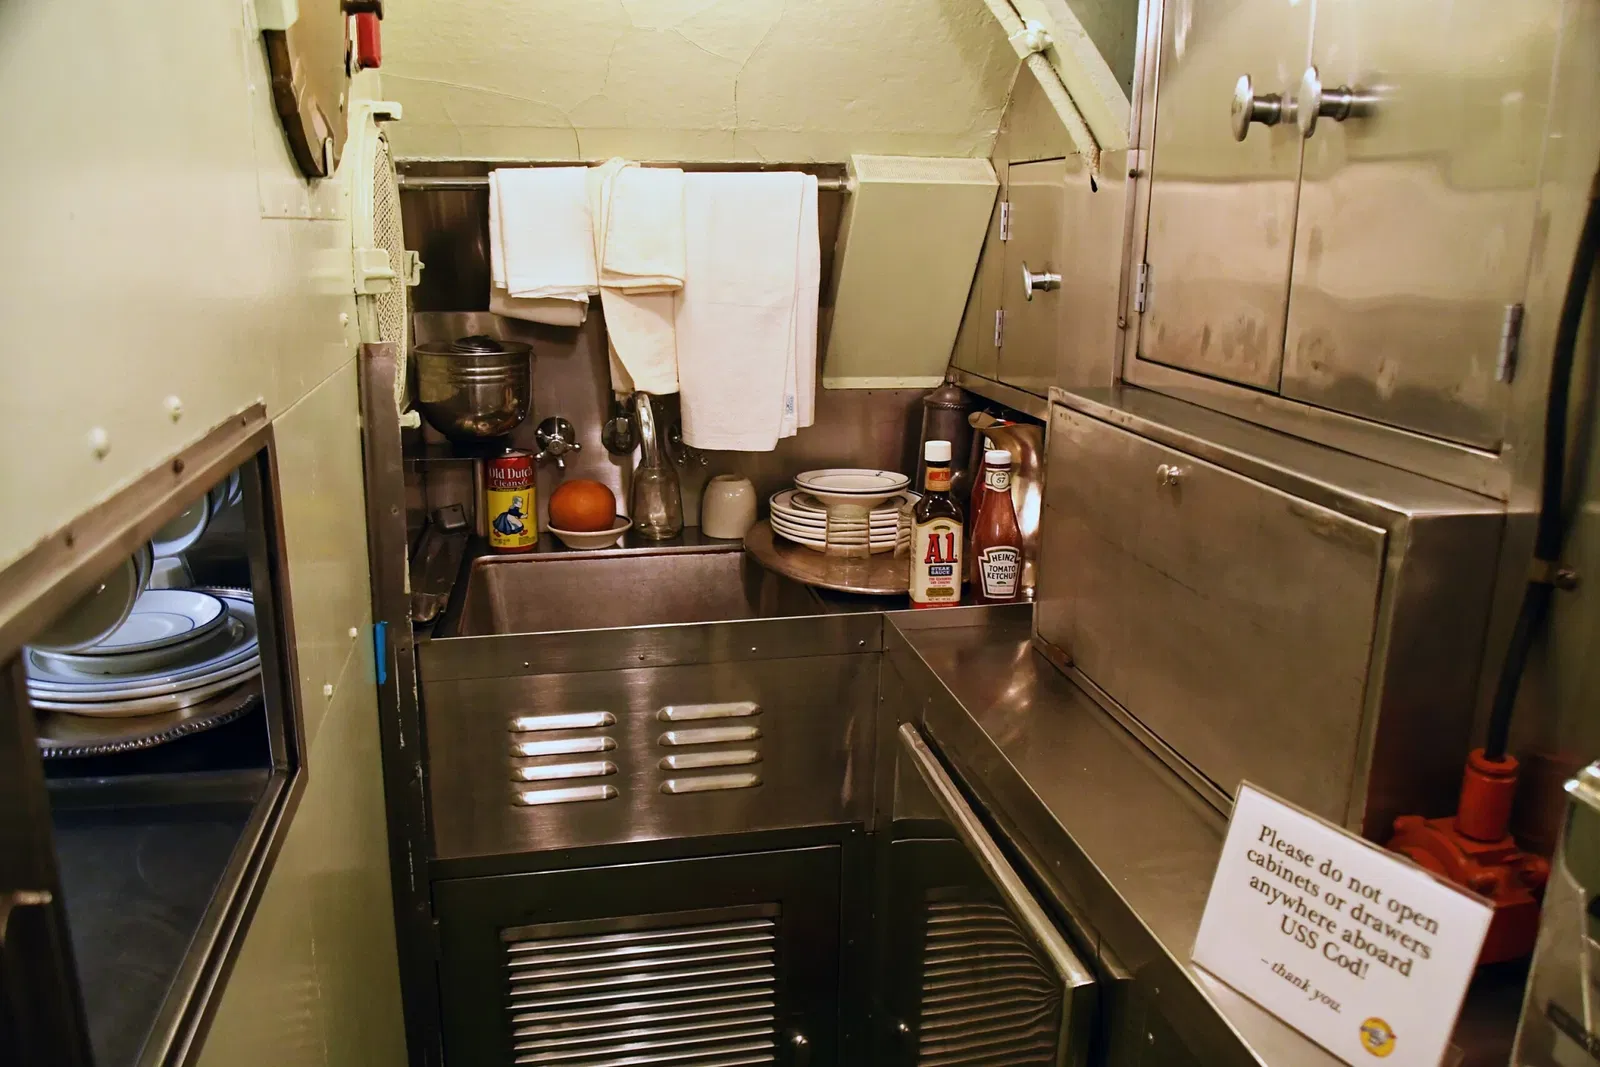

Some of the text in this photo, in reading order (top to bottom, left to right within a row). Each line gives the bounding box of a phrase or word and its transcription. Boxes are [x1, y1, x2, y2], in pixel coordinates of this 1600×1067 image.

[489, 466, 532, 479] Old Dutch
[989, 564, 1016, 572] TOMATO
[992, 554, 1015, 562] HEINZ
[1247, 848, 1431, 960] cabinets or drawers
[1258, 825, 1439, 936] Please do not open
[1250, 874, 1413, 978] anywhere aboard
[1280, 914, 1370, 980] USS Cod!
[1270, 962, 1312, 993] thank
[1308, 990, 1342, 1014] you.
